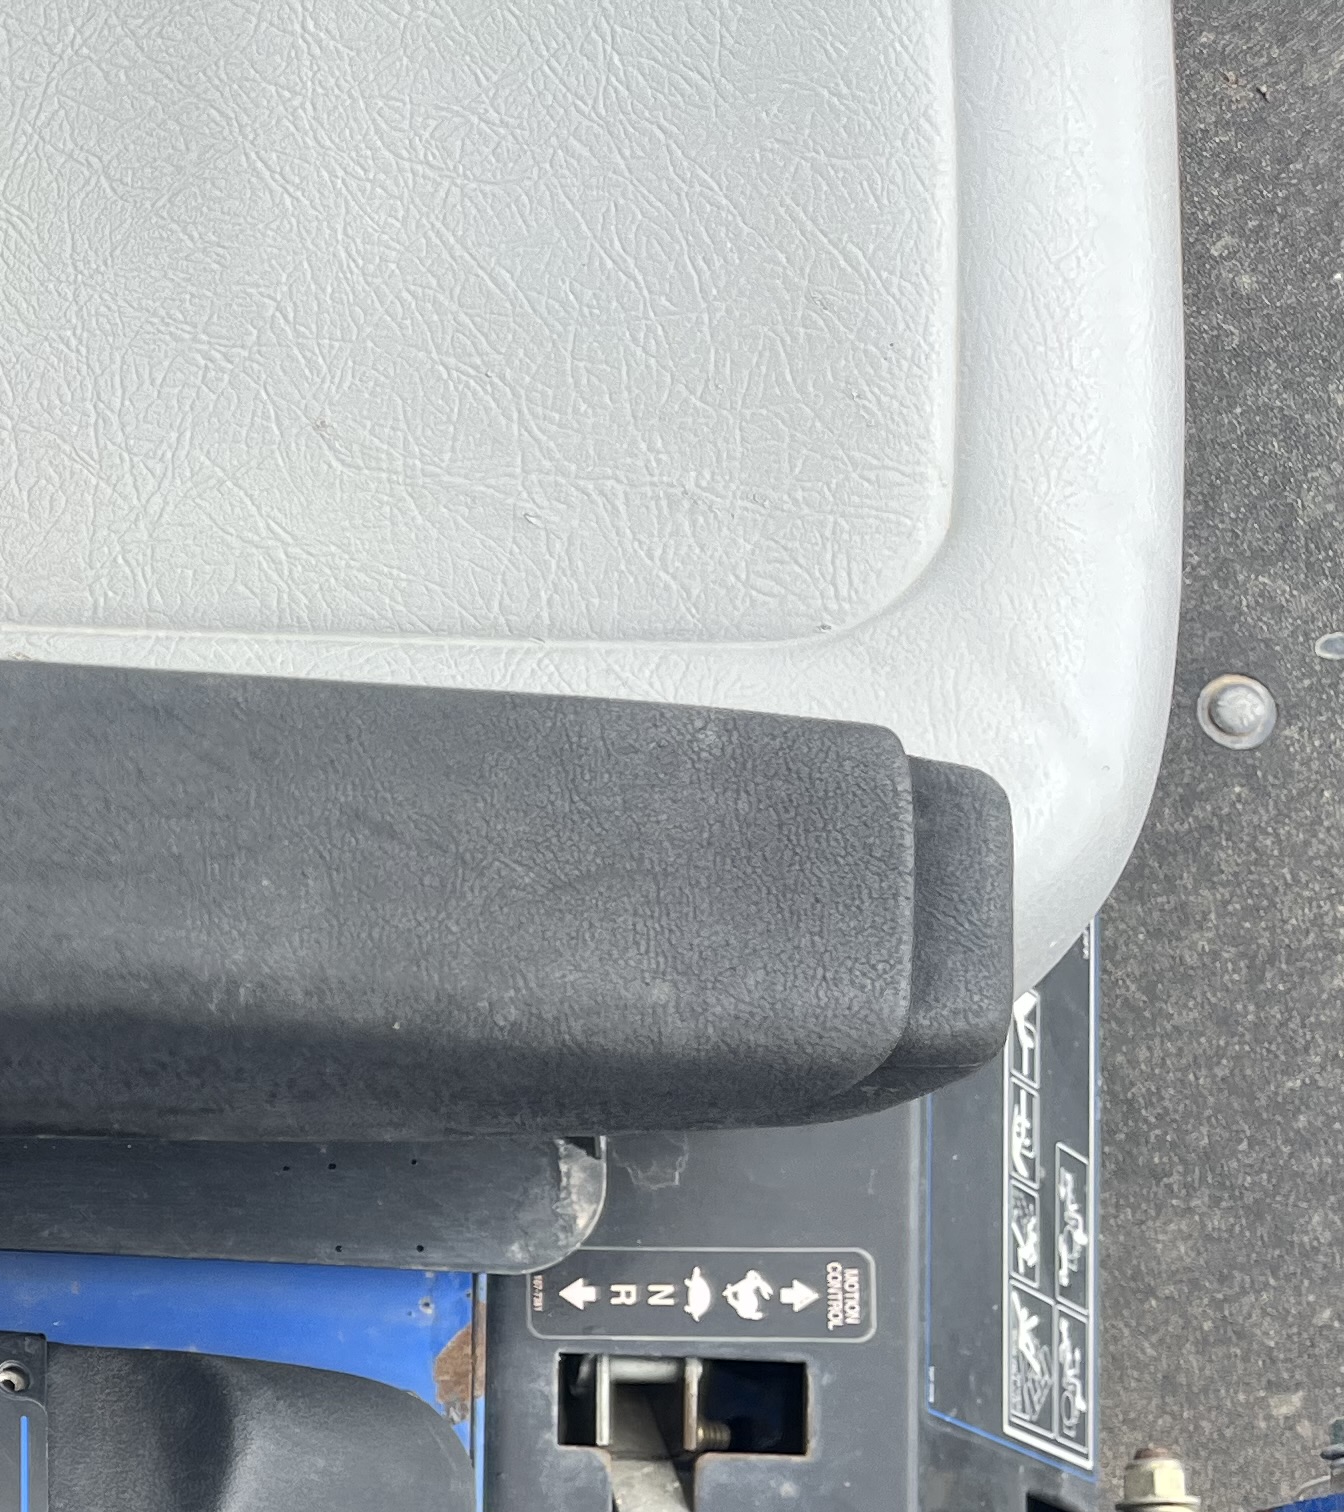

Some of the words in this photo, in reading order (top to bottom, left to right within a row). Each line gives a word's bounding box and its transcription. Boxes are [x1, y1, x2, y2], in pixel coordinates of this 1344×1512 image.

[610, 1284, 638, 1306] R
[647, 1284, 676, 1307] N
[825, 1261, 845, 1331] CONTROL
[843, 1267, 861, 1325] MOTION
